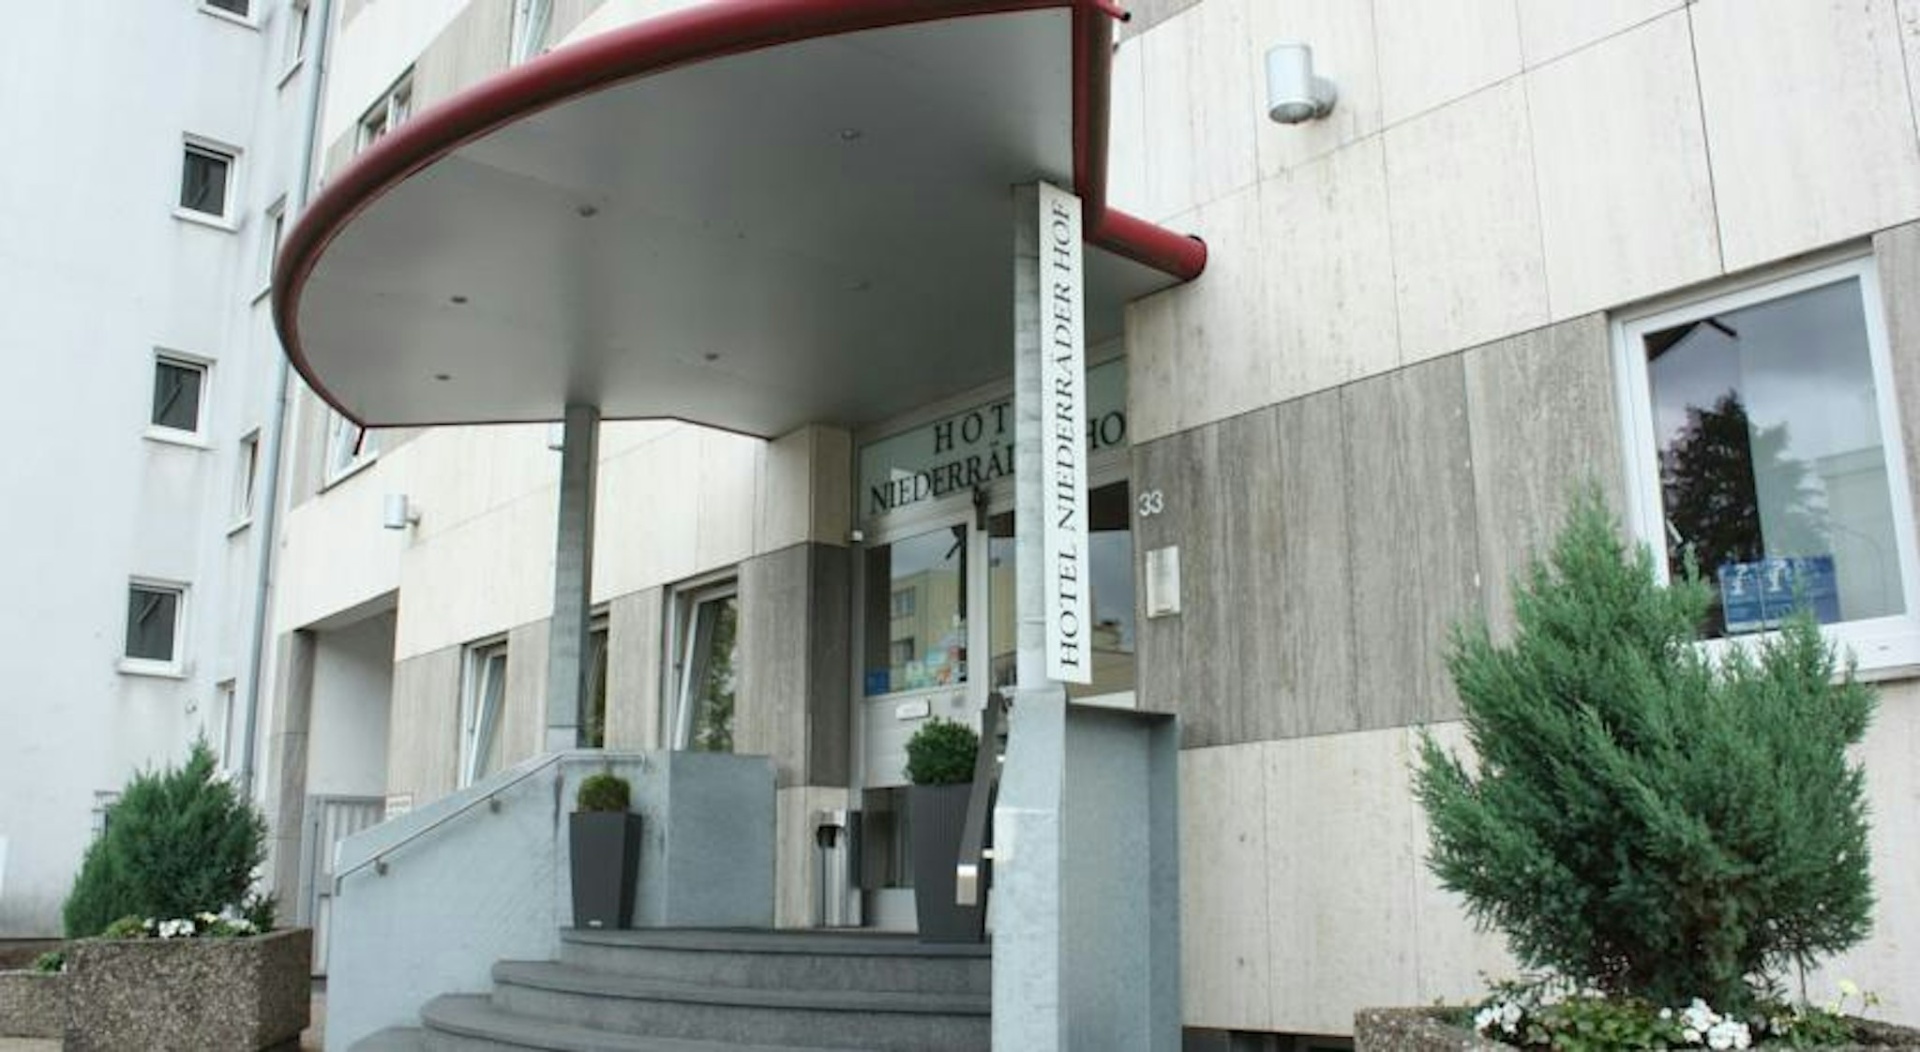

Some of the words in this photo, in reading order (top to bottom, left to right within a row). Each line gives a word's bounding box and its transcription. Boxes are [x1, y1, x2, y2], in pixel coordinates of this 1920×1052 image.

[1052, 199, 1072, 272] HOF
[869, 440, 1015, 516] NIEDERRÄ
[1086, 409, 1127, 451] HO
[932, 401, 1012, 455] HOT
[1139, 489, 1164, 517] 33
[1057, 545, 1080, 668] HOTEL
